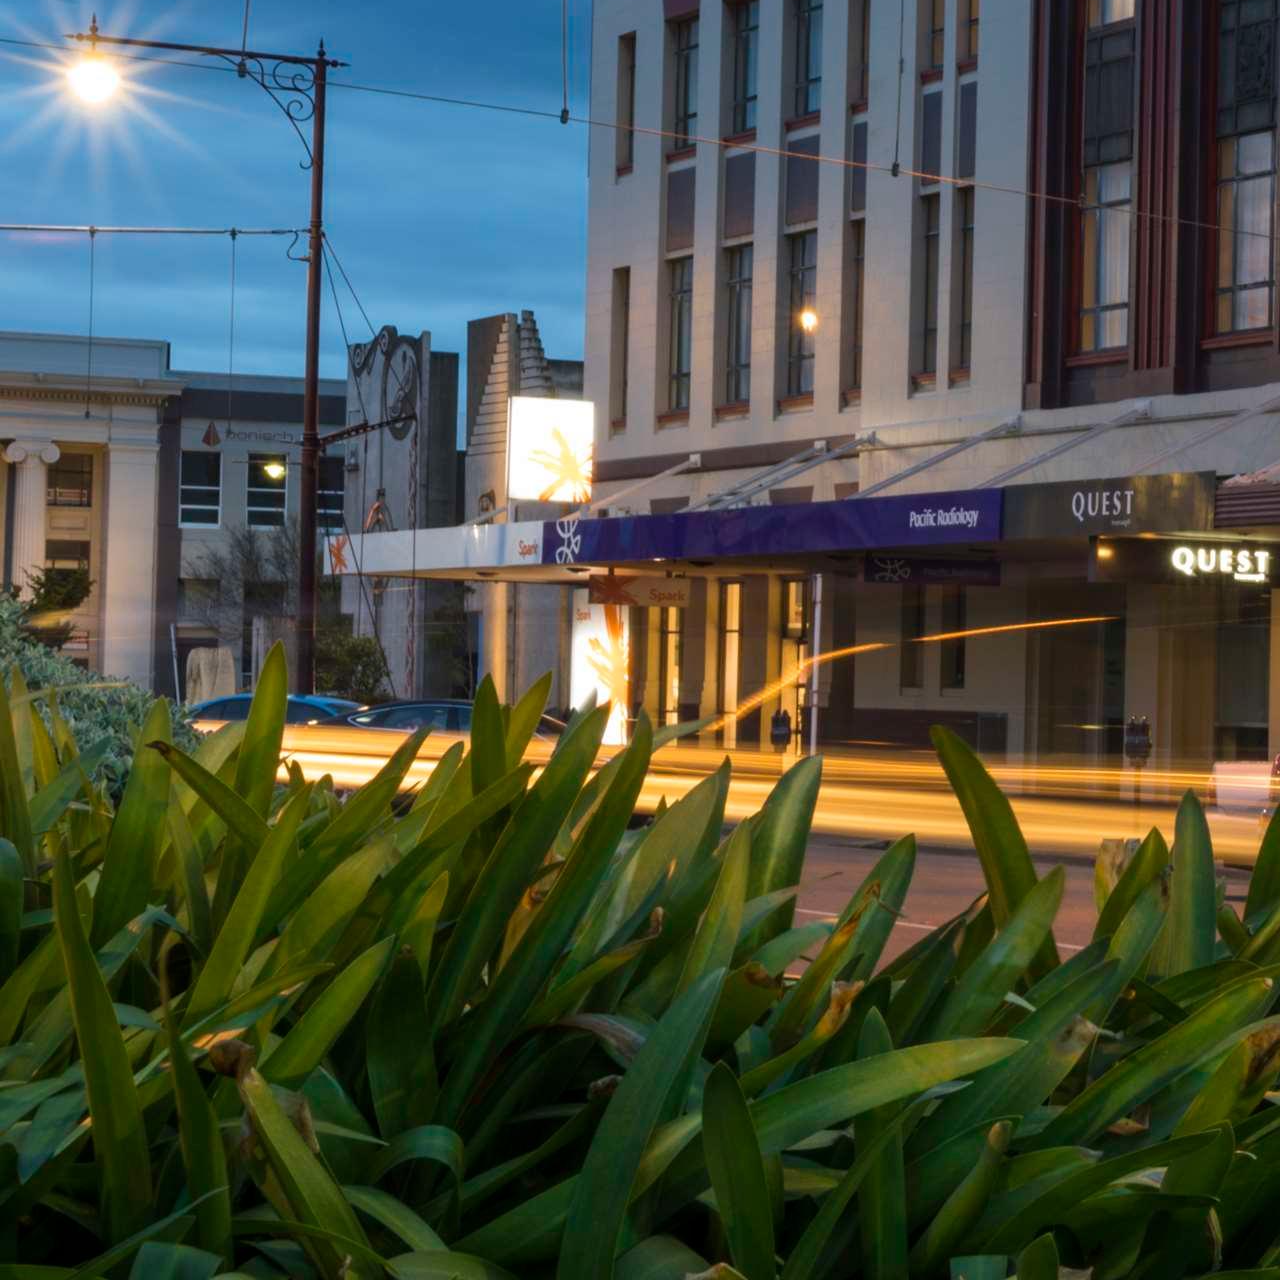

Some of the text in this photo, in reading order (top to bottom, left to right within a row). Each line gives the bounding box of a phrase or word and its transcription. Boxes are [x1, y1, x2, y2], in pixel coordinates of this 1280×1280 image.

[910, 506, 979, 528] Pacific Radiology
[1072, 489, 1134, 522] QUEST
[1172, 545, 1269, 577] QUEST
[649, 588, 685, 602] Spark
